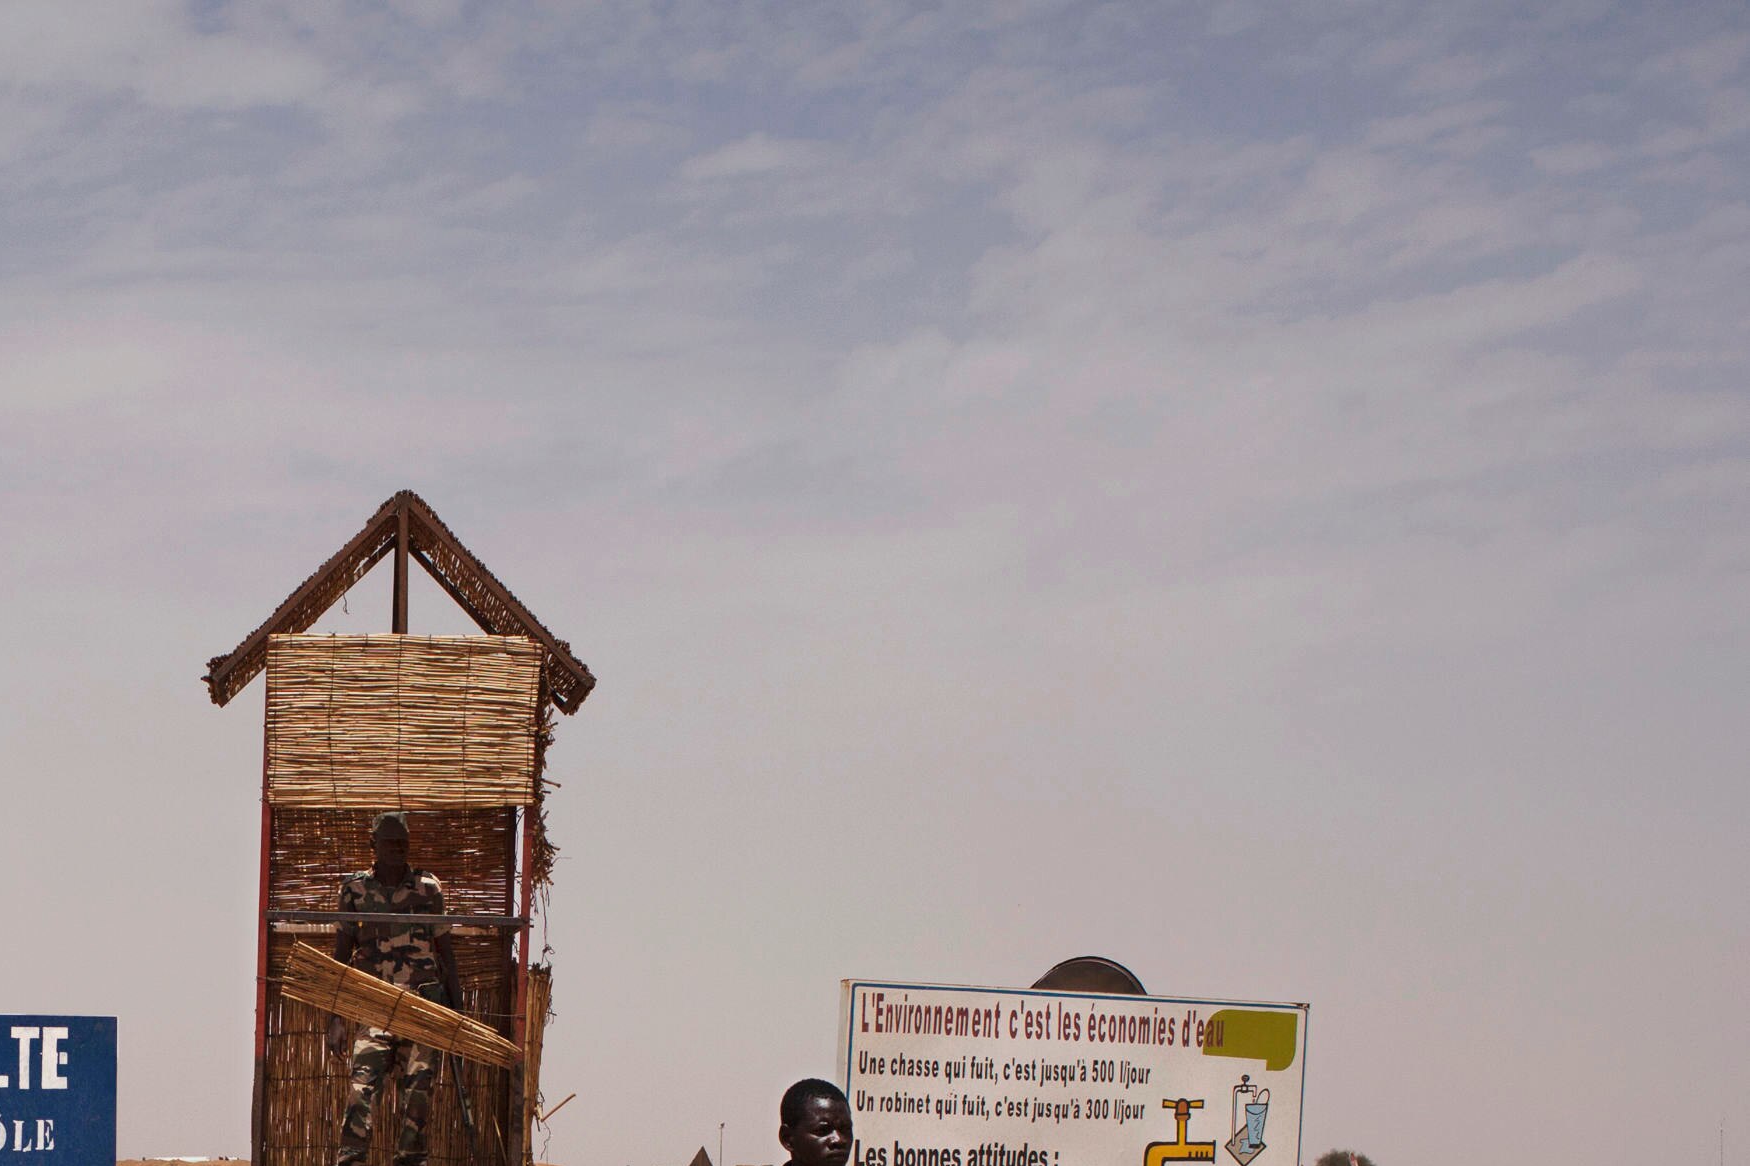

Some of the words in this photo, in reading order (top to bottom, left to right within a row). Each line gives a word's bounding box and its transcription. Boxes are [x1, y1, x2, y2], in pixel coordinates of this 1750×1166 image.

[861, 992, 1001, 1039] L'Environnement
[1009, 1000, 1051, 1040] c'est
[1057, 1001, 1081, 1042] les
[1087, 1003, 1176, 1046] économies
[1181, 1010, 1225, 1048] d'eau
[858, 1050, 885, 1075] Une
[890, 1053, 939, 1078] chasse
[944, 1055, 966, 1084] qui
[970, 1056, 998, 1085] fuit,
[1003, 1057, 1036, 1082] c'est
[1039, 1058, 1087, 1087] jusqu'à
[1092, 1060, 1114, 1083] 500
[1119, 1061, 1151, 1089] l/jour
[856, 1090, 874, 1112] Un
[879, 1092, 930, 1114] robinet
[935, 1093, 958, 1120] qui
[961, 1094, 990, 1121] fuit,
[995, 1096, 1028, 1118] c'est
[1031, 1097, 1080, 1124] jusqu'à
[1085, 1099, 1109, 1120] 300
[1113, 1100, 1145, 1125] l/jour
